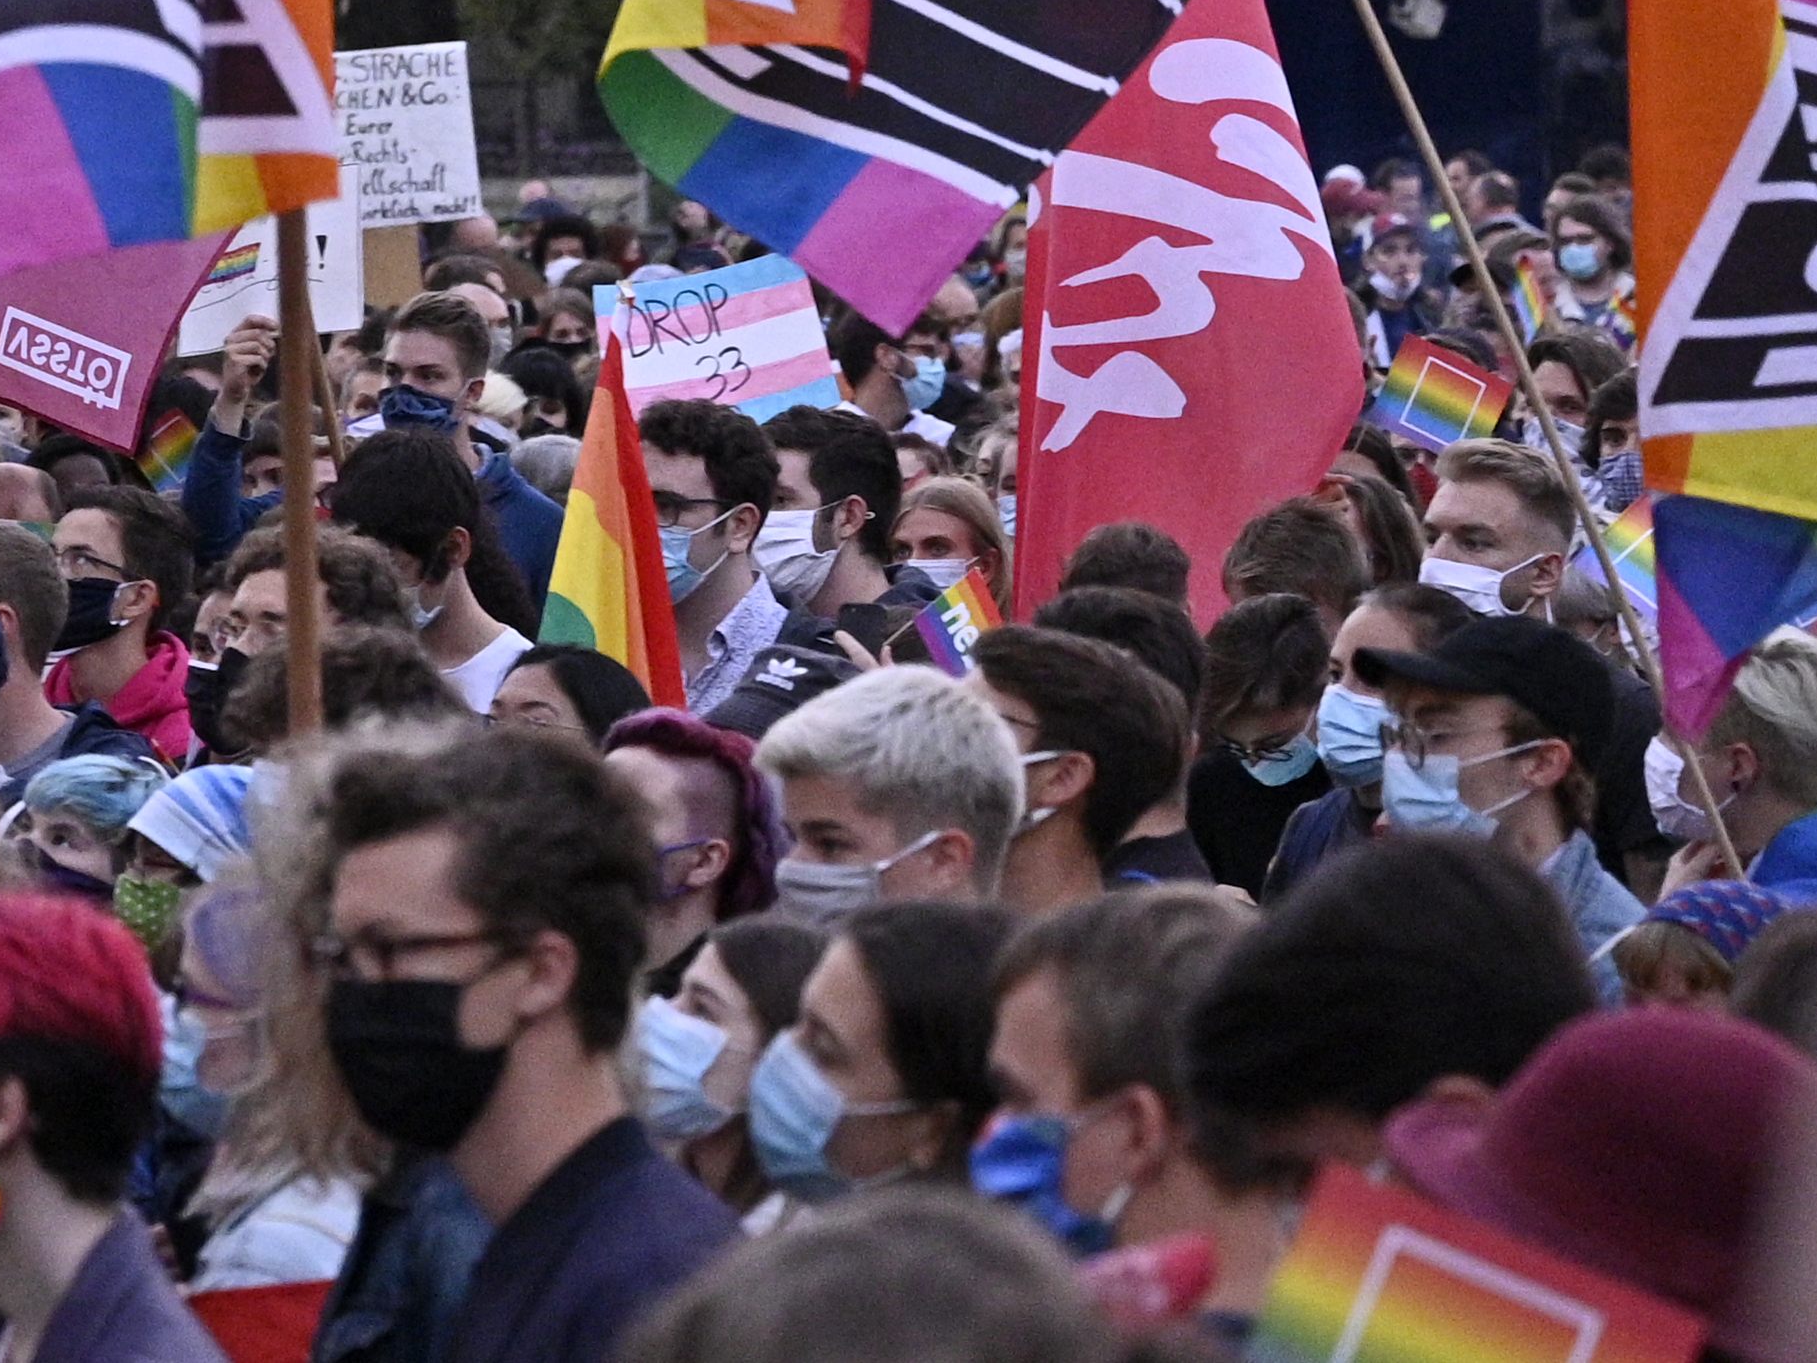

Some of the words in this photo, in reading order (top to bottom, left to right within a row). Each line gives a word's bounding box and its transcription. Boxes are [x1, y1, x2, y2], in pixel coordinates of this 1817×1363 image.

[350, 49, 459, 84] STRACHE
[626, 283, 729, 359] DROP
[694, 346, 753, 401] 33
